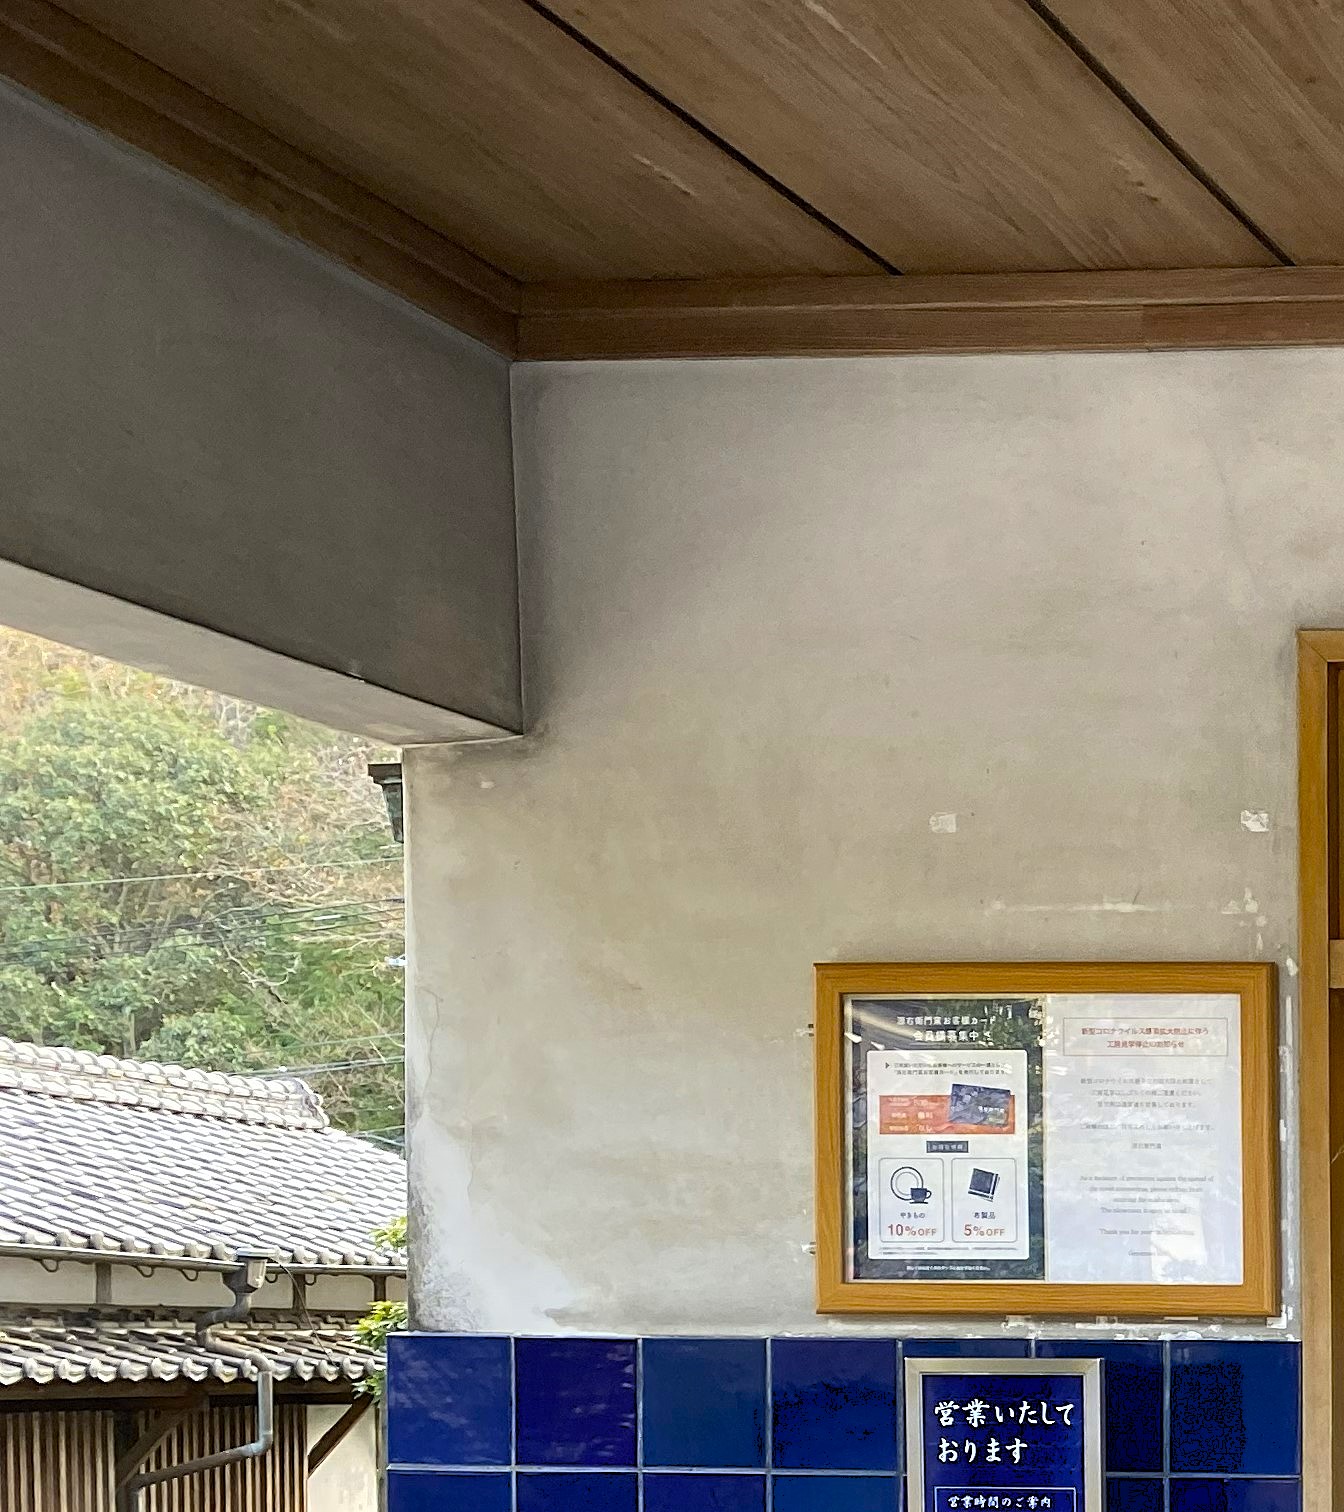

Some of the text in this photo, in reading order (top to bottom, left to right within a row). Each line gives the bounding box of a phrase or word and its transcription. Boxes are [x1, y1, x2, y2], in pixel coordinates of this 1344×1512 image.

[934, 1399, 1075, 1427] 営業いたして
[938, 1437, 1028, 1464] おります
[948, 1494, 1051, 1509] 営業時間のご案内
